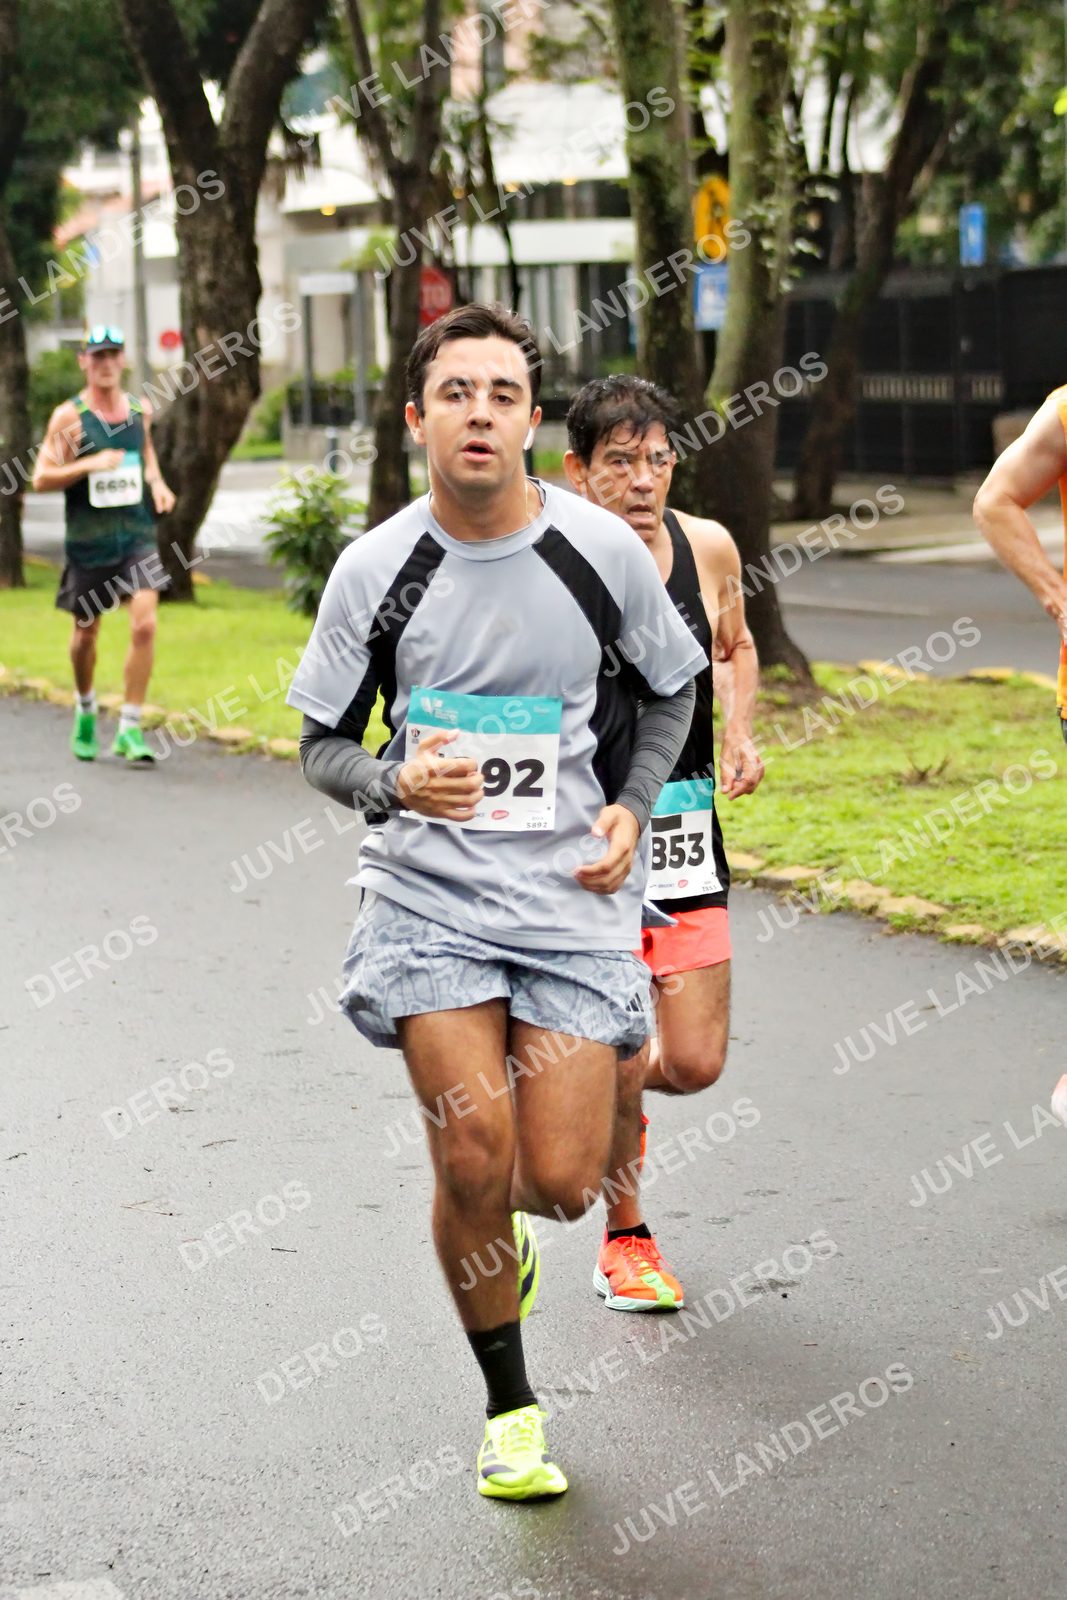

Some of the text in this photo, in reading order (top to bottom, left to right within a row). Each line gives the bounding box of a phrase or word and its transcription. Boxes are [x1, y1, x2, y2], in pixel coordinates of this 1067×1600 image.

[422, 284, 450, 309] TO
[456, 756, 546, 798] 92
[651, 832, 705, 871] 853
